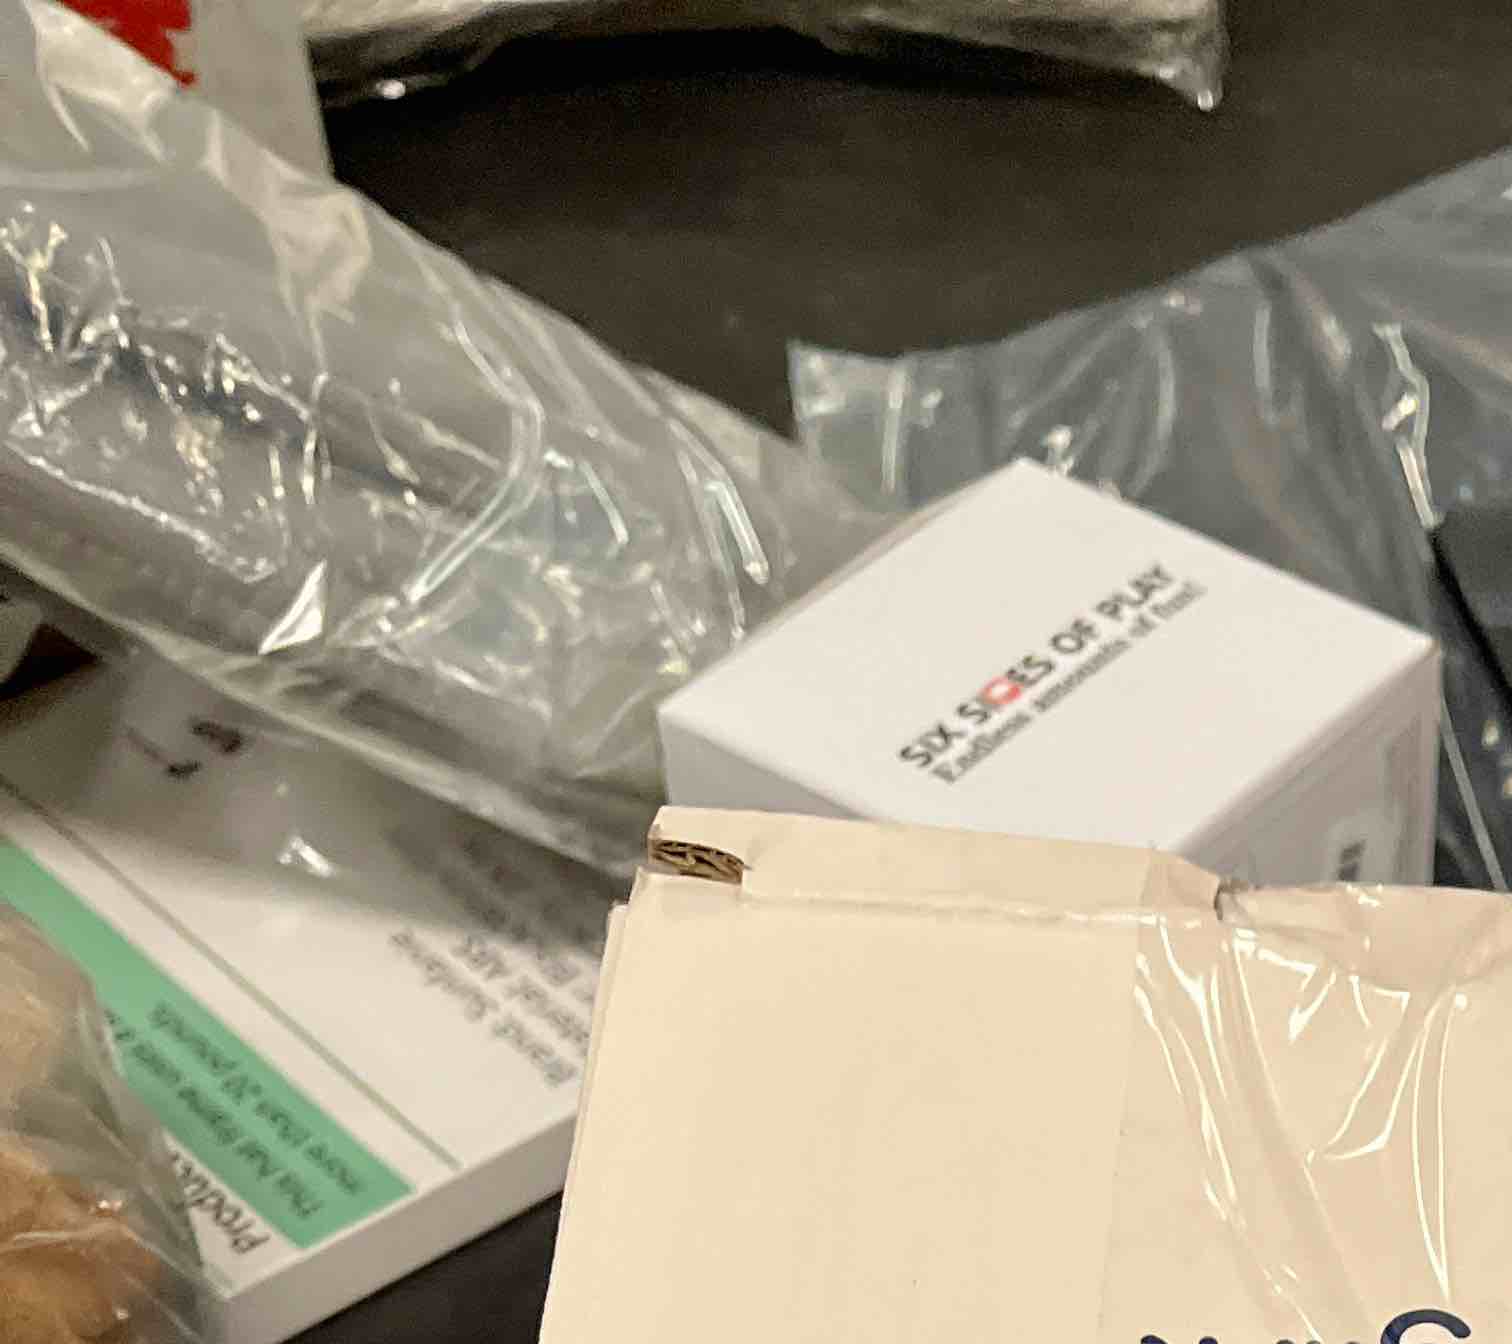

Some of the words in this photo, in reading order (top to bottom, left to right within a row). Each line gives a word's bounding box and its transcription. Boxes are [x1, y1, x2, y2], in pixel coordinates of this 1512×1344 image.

[899, 722, 970, 770] SIX
[1050, 615, 1100, 656] OF
[1096, 562, 1175, 623] PLAY
